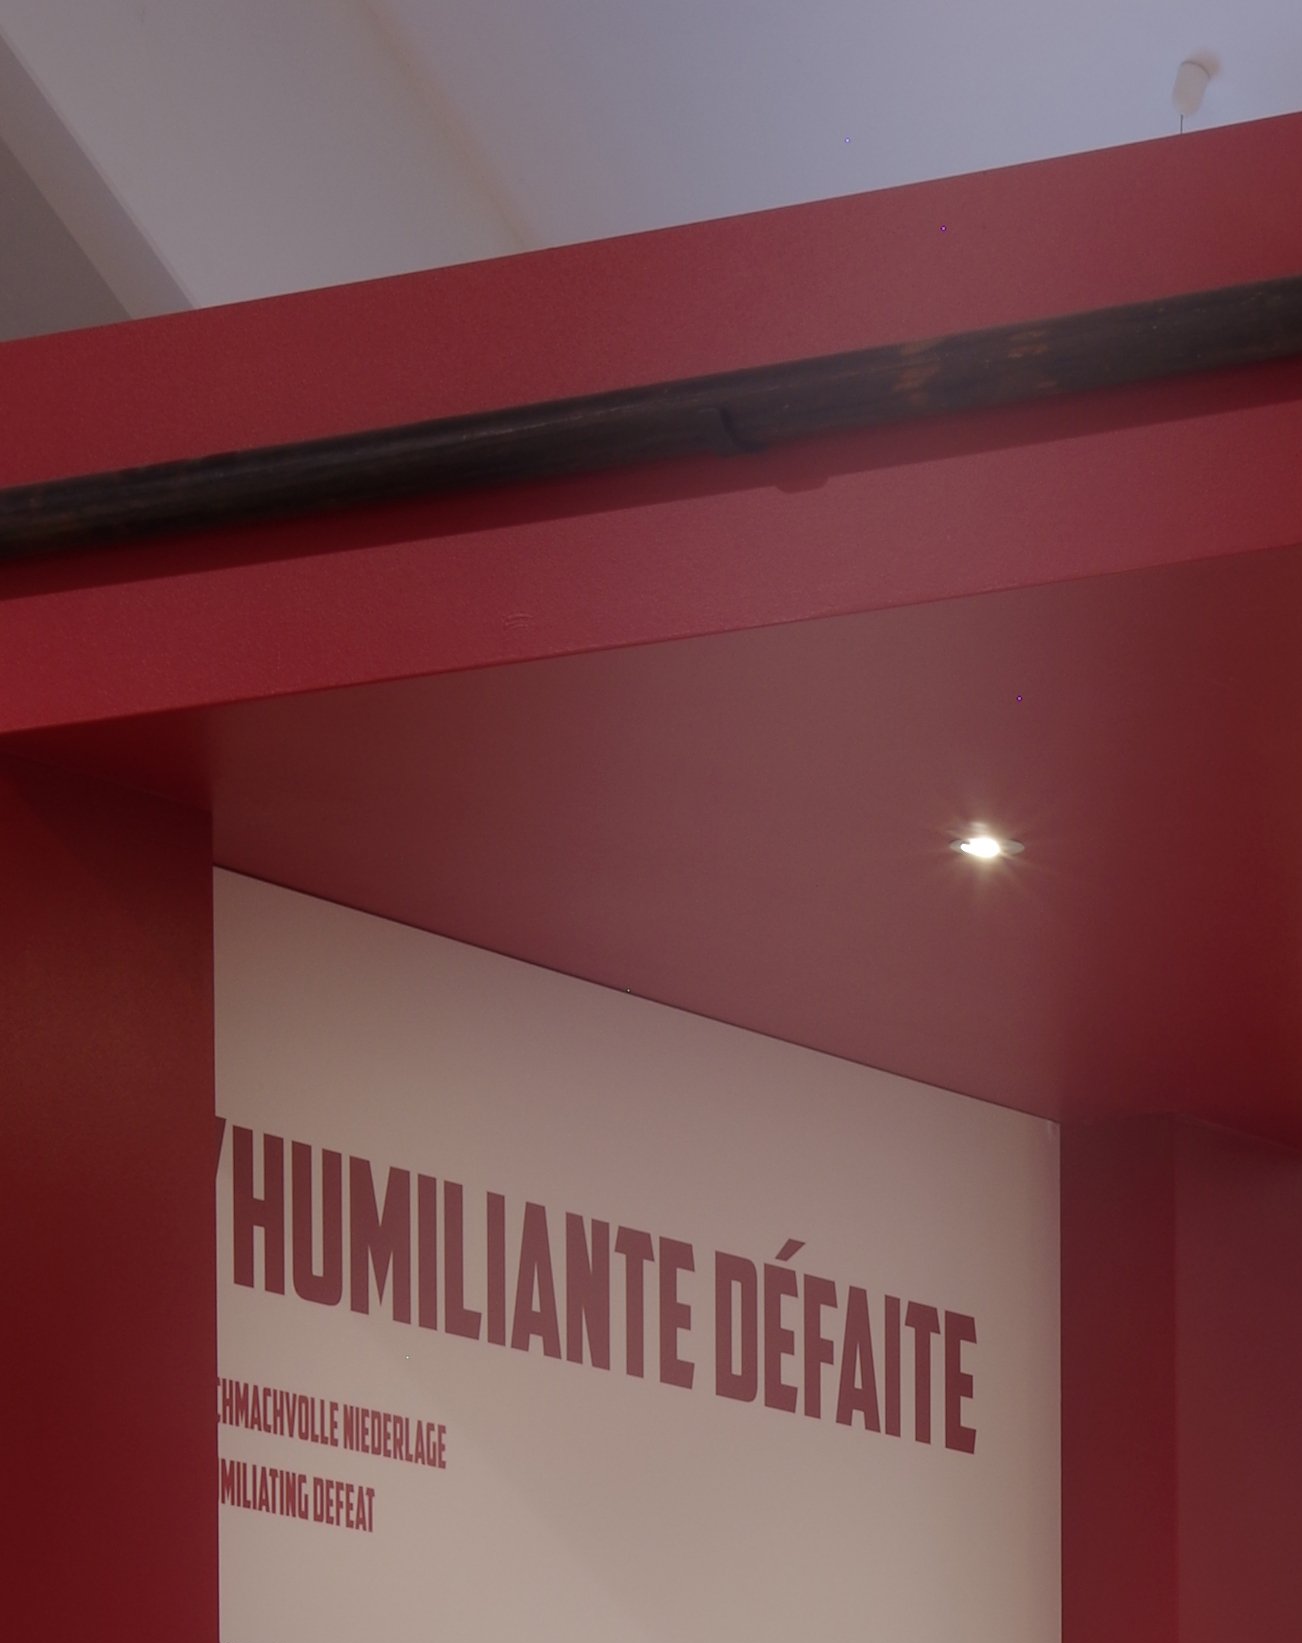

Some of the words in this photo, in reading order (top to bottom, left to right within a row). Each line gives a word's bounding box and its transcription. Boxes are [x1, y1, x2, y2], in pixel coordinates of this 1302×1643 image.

[715, 1238, 977, 1454] DÉFAITE
[343, 1404, 447, 1469] NIEDERLAGE
[313, 1477, 375, 1532] DEFEAT
